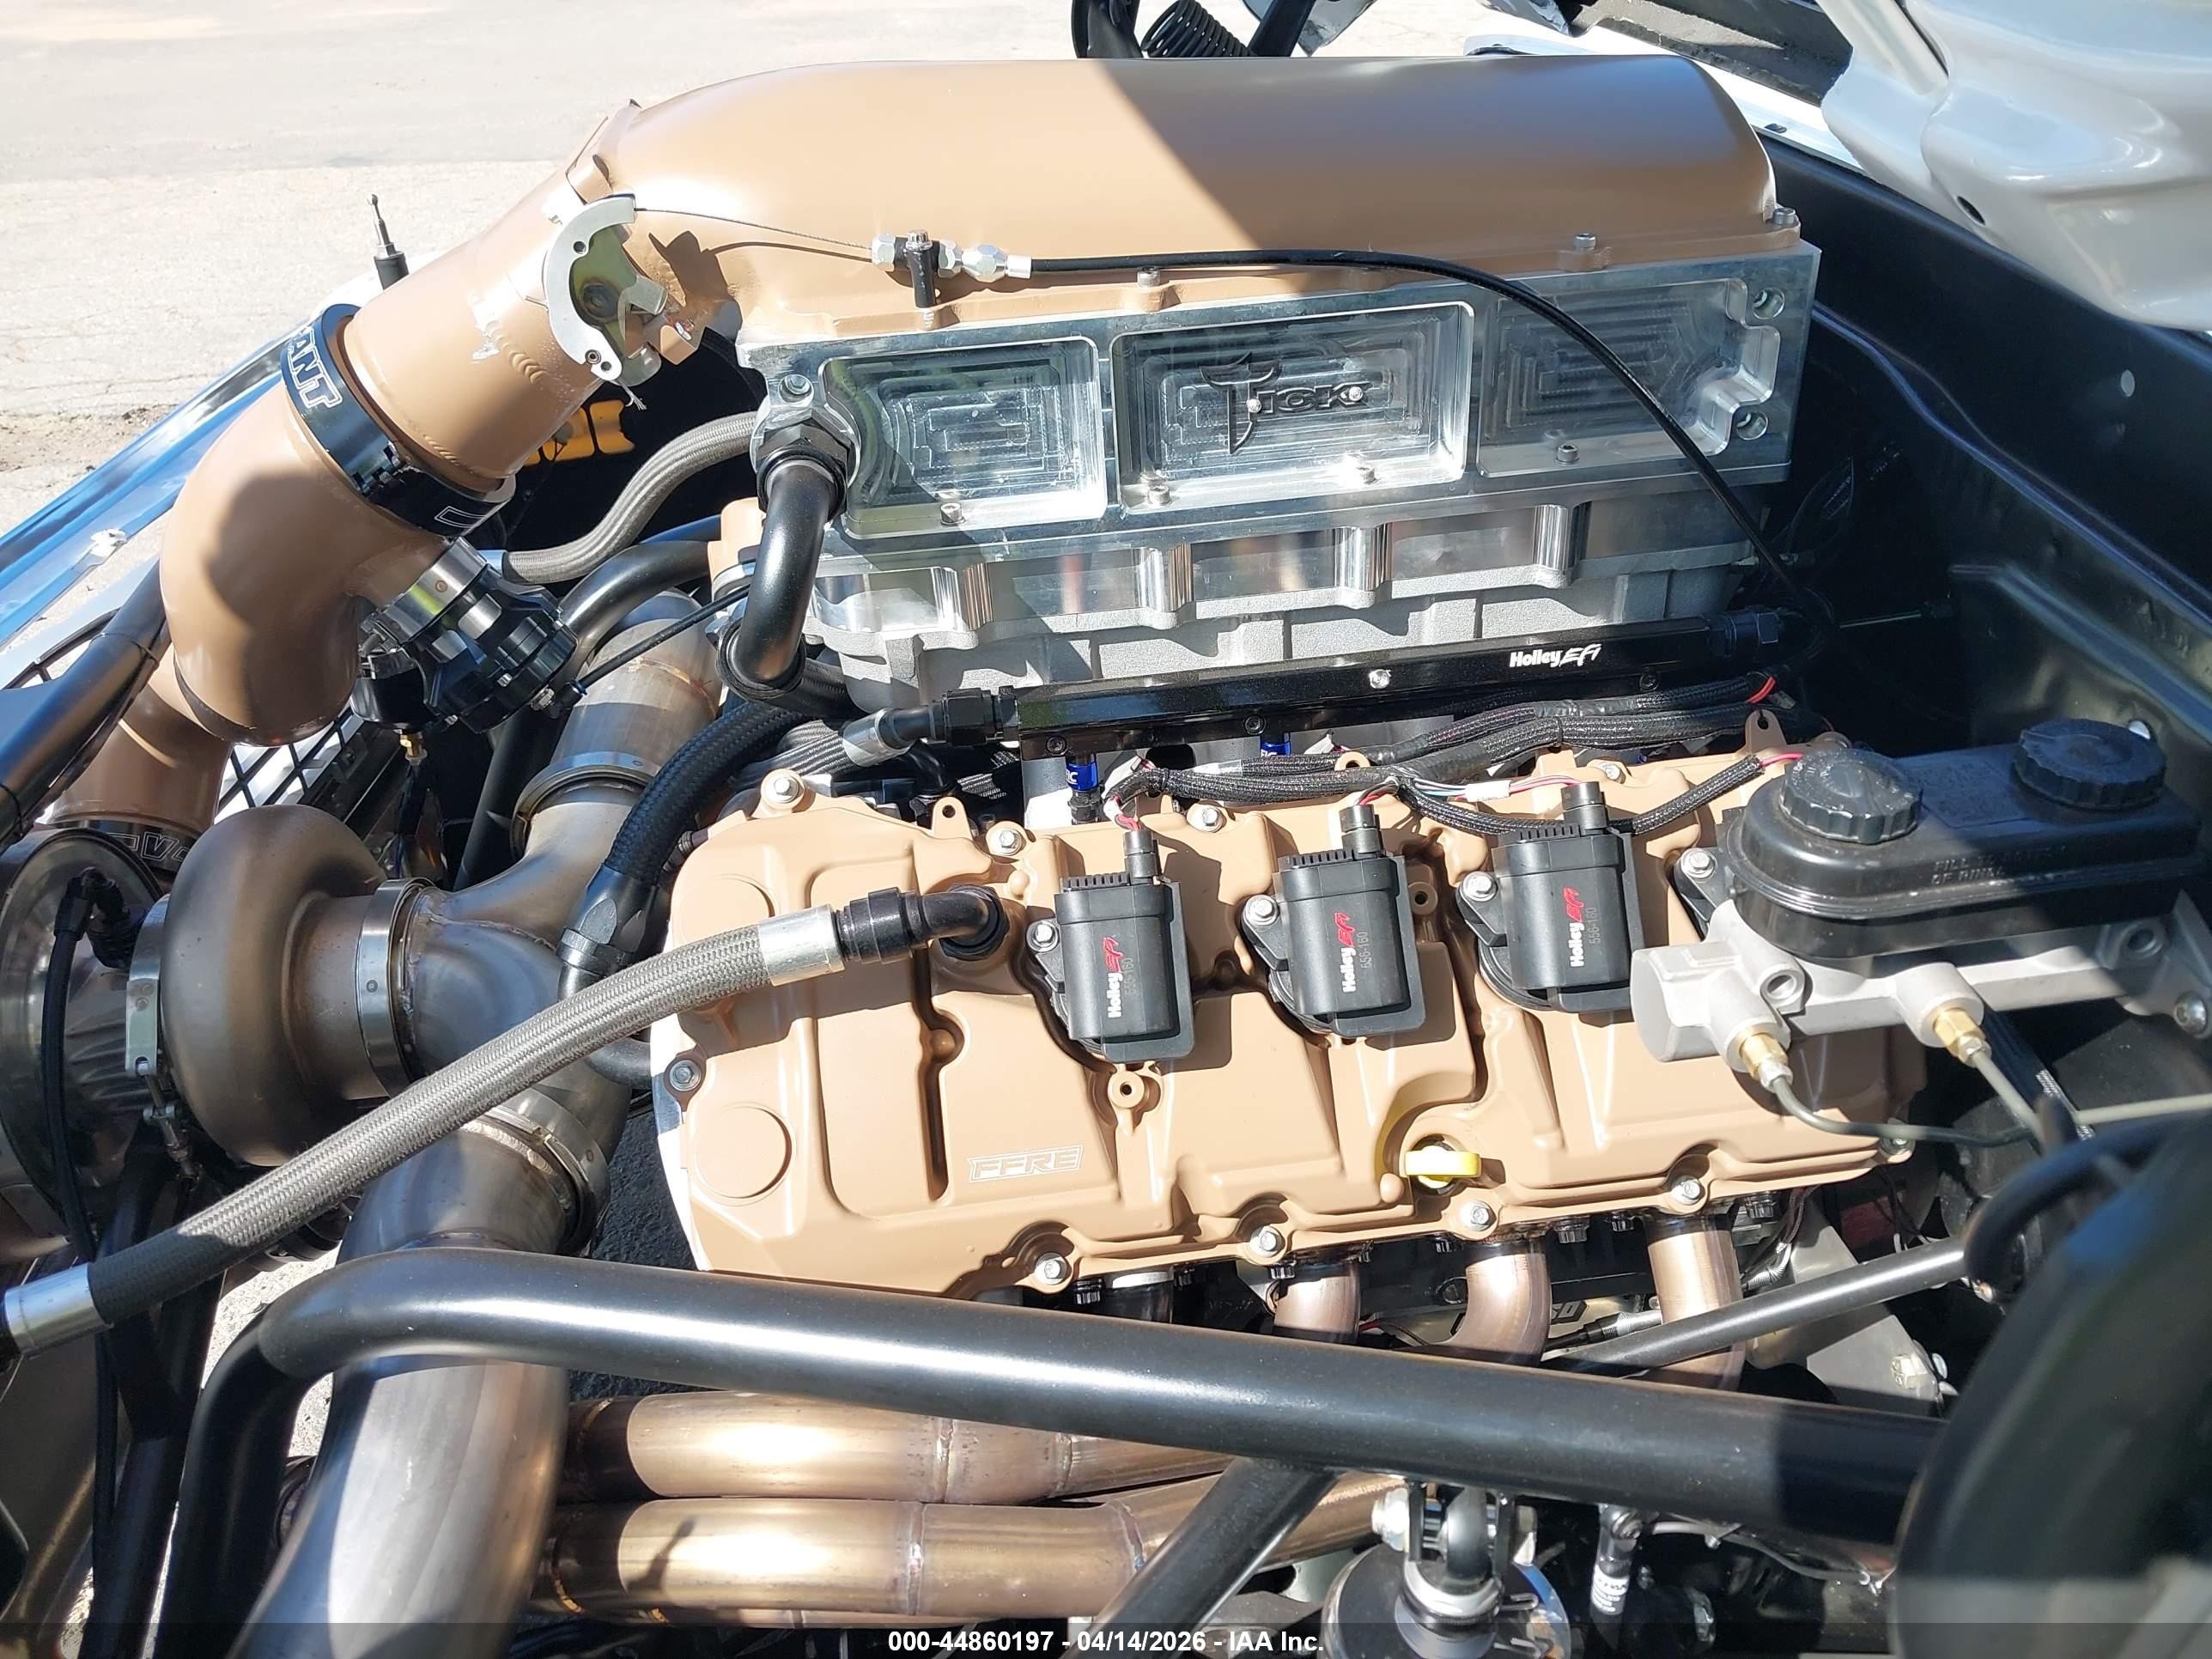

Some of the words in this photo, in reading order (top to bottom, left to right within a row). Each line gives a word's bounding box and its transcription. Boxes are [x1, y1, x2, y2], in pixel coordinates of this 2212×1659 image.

[288, 327, 343, 408] ANT
[1509, 649, 1563, 668] Holley
[1568, 922, 1585, 967] Holley
[1585, 907, 1601, 944] 556-160
[1340, 947, 1357, 993] Holley
[1357, 932, 1372, 969] 556-160
[1106, 972, 1123, 1018] Holley
